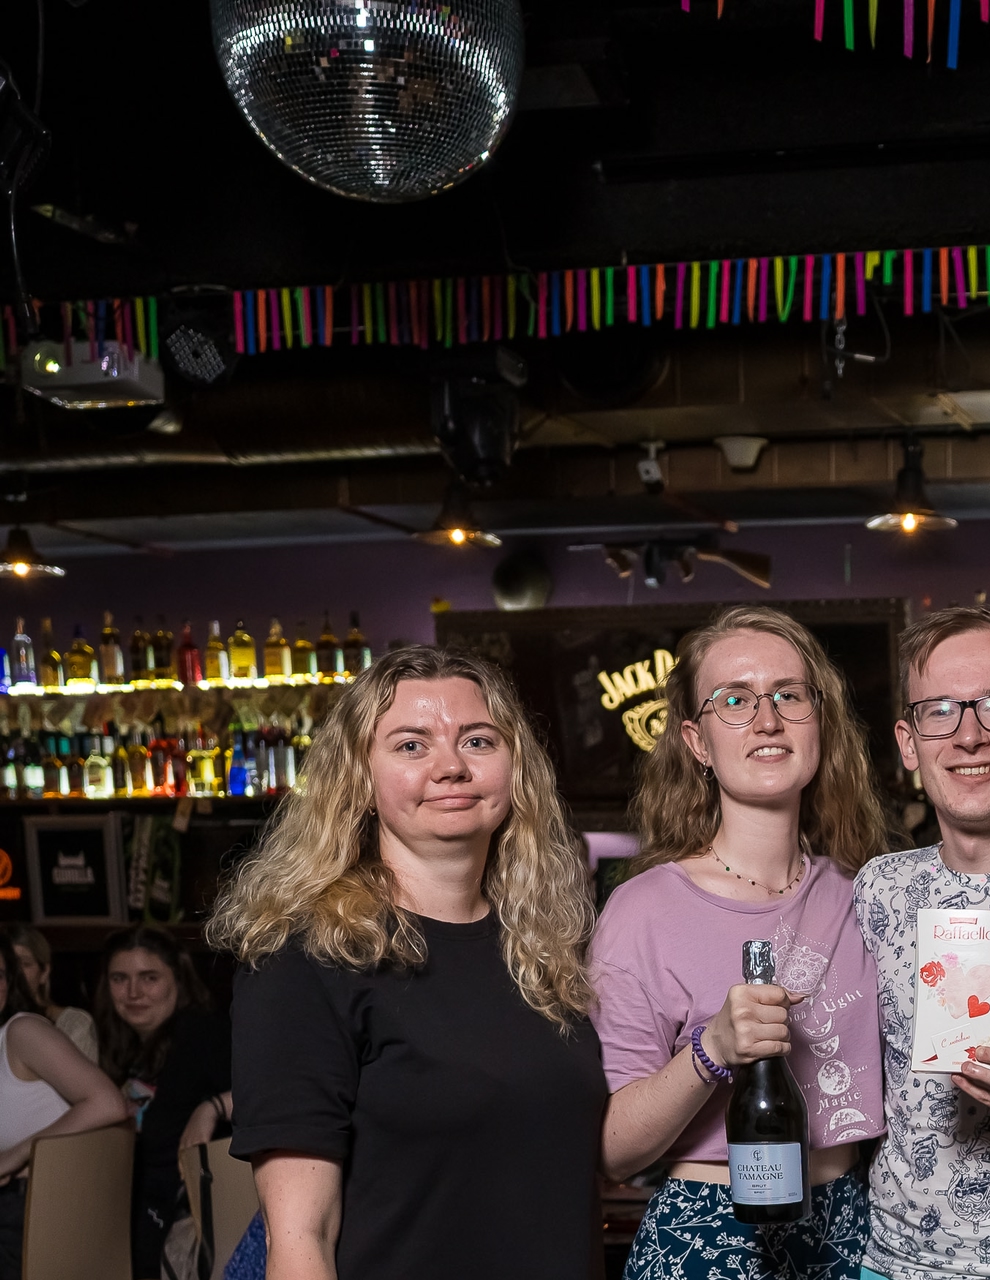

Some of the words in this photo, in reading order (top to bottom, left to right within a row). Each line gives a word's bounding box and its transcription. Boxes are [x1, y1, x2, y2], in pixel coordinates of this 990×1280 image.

[598, 660, 656, 710] JACK
[821, 990, 863, 1012] Light
[816, 1091, 861, 1115] Magic
[737, 1163, 782, 1172] CHATEAU
[738, 1172, 784, 1180] TAMAGNE
